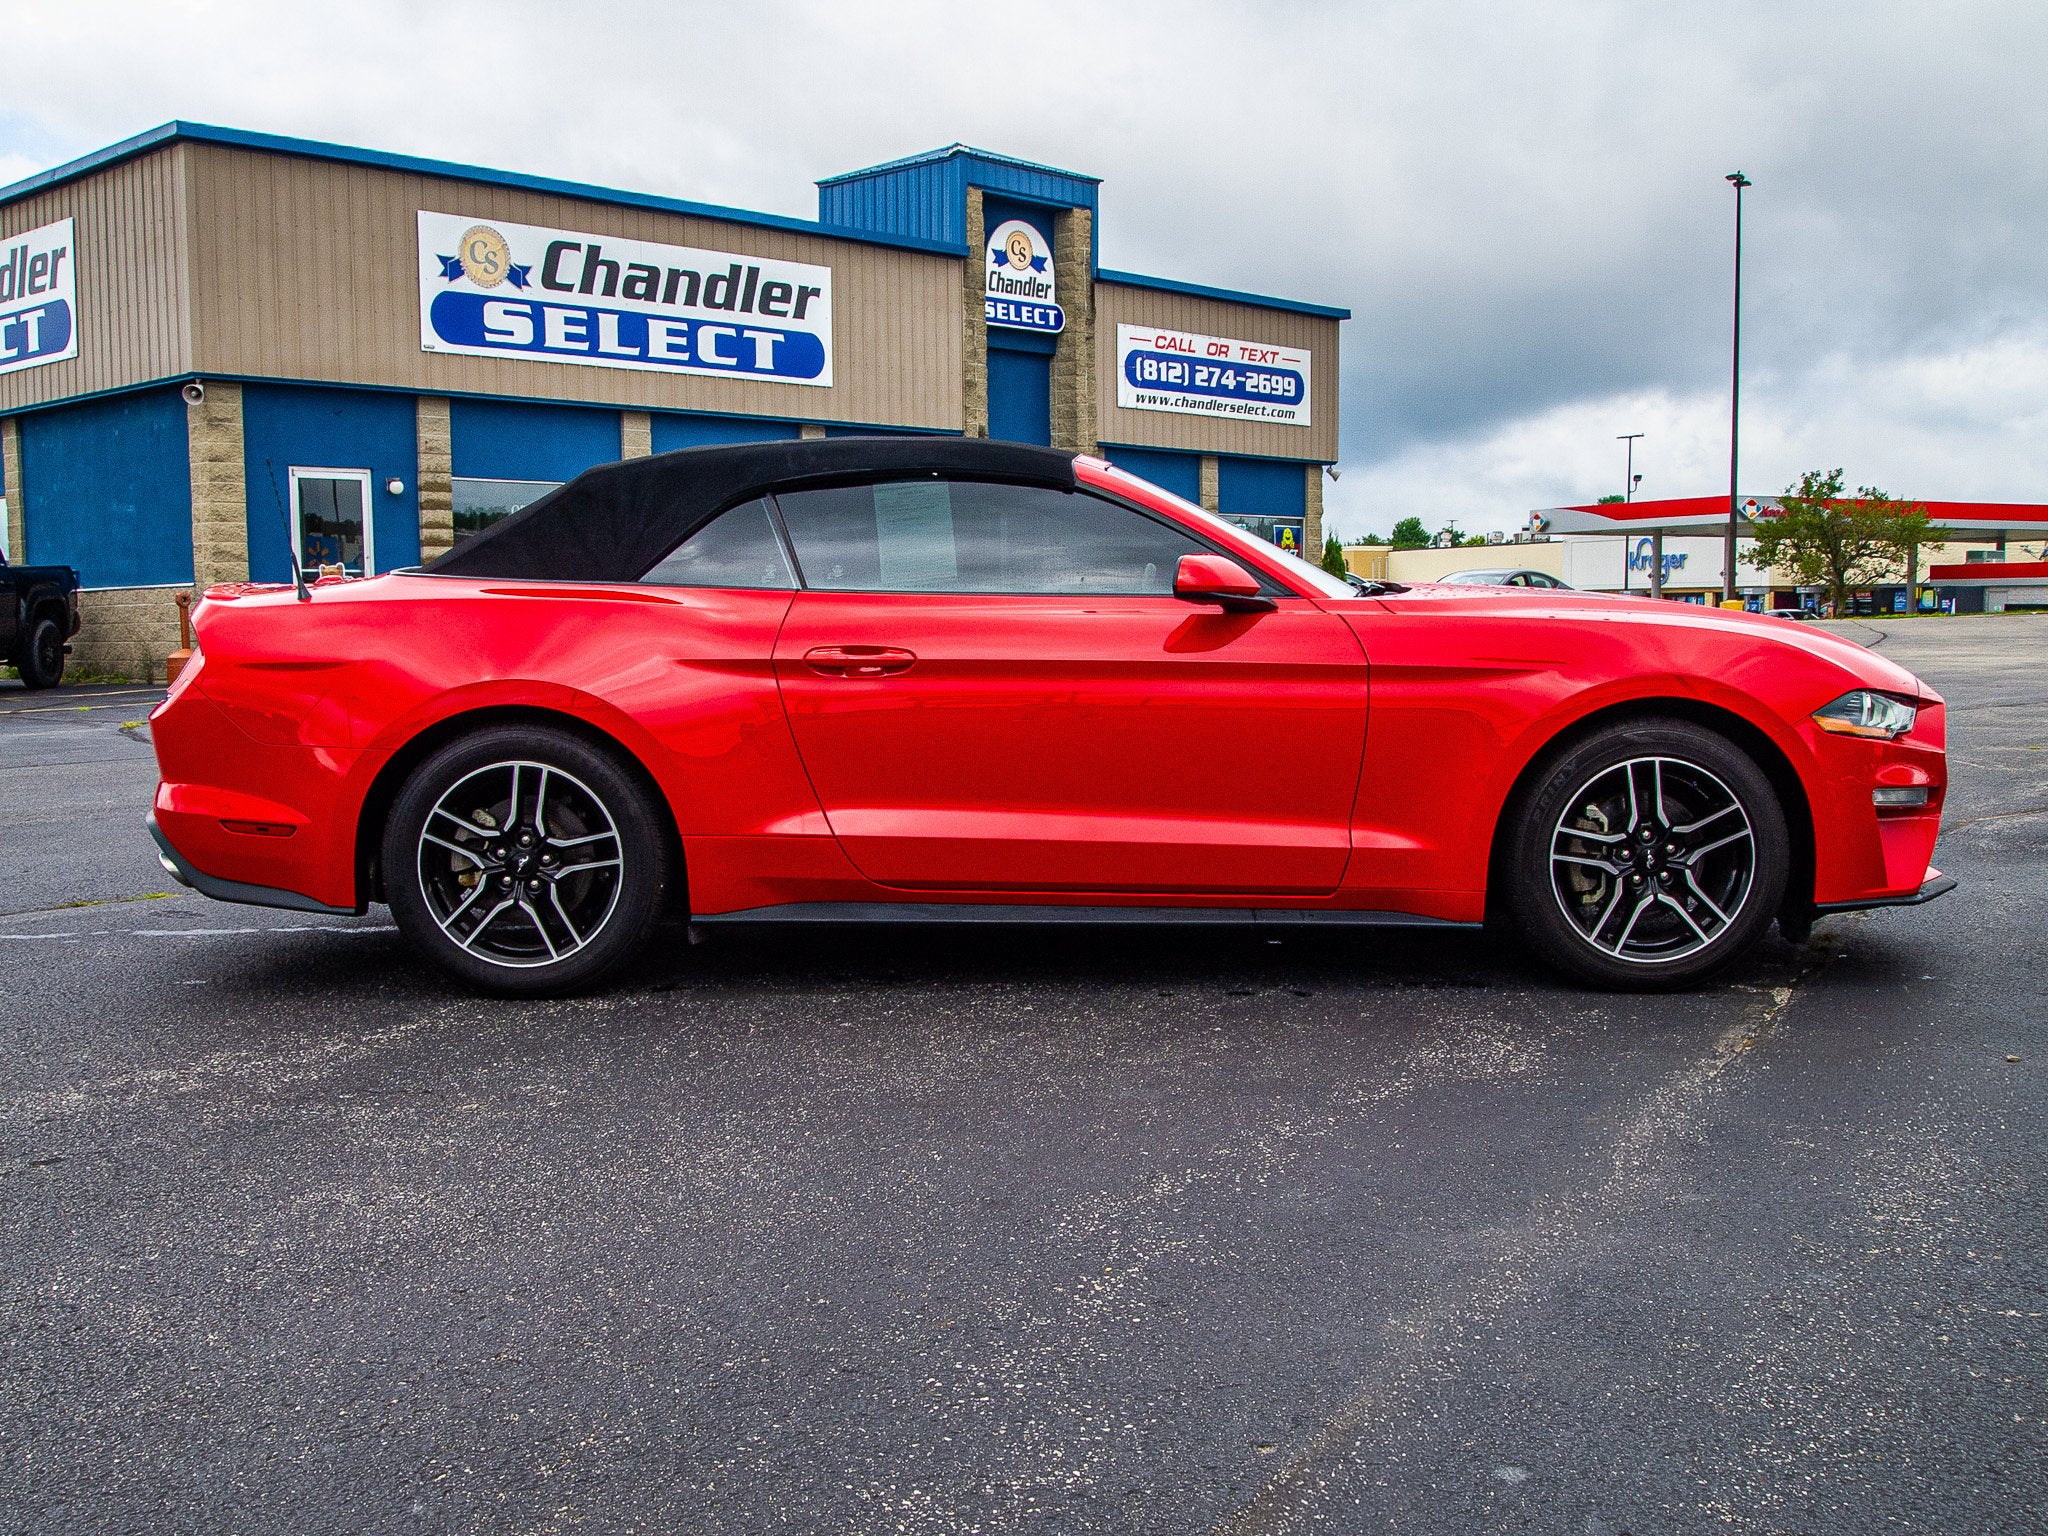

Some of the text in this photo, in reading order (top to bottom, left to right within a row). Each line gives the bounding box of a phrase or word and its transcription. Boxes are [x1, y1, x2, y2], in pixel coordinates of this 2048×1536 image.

[469, 240, 499, 275] CS
[1010, 239, 1027, 263] CS
[540, 240, 821, 320] Chandler
[988, 270, 1052, 299] Chandler
[985, 301, 1058, 326] SELECT
[482, 300, 785, 370] SELECT
[1154, 335, 1280, 365] CALL OR TEXT
[1135, 356, 1296, 397] (812) 274-2699
[1136, 392, 1296, 420] www.chandlerselect.com
